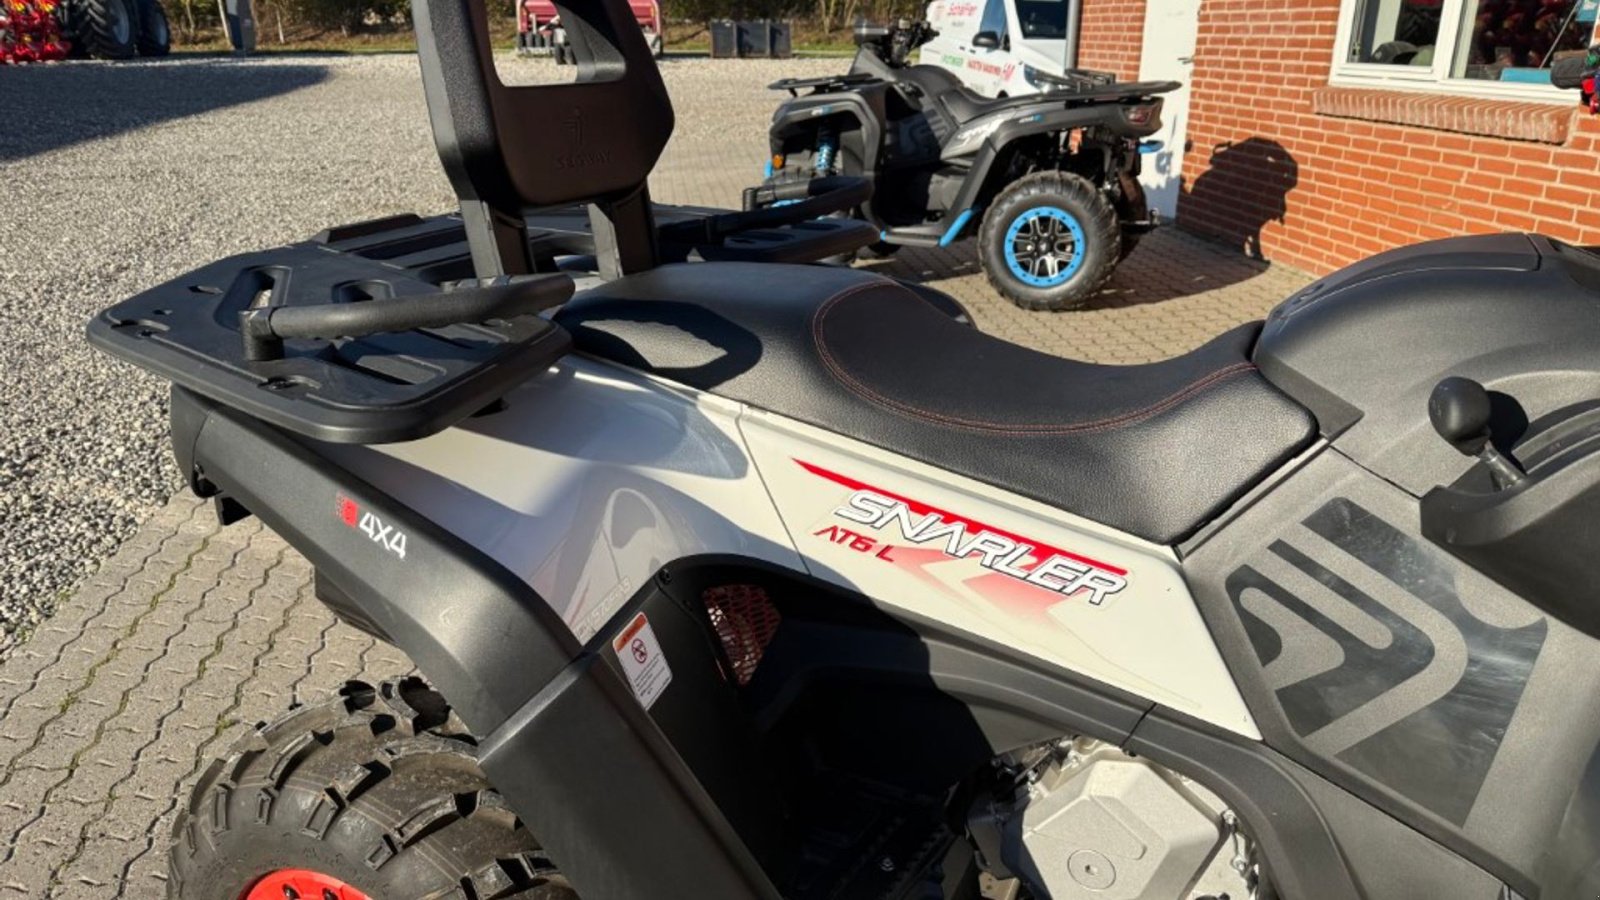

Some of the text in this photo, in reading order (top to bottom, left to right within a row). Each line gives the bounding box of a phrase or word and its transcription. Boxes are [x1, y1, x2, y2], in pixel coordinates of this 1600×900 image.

[813, 525, 896, 562] AT6 L
[834, 489, 1128, 605] SNARLER
